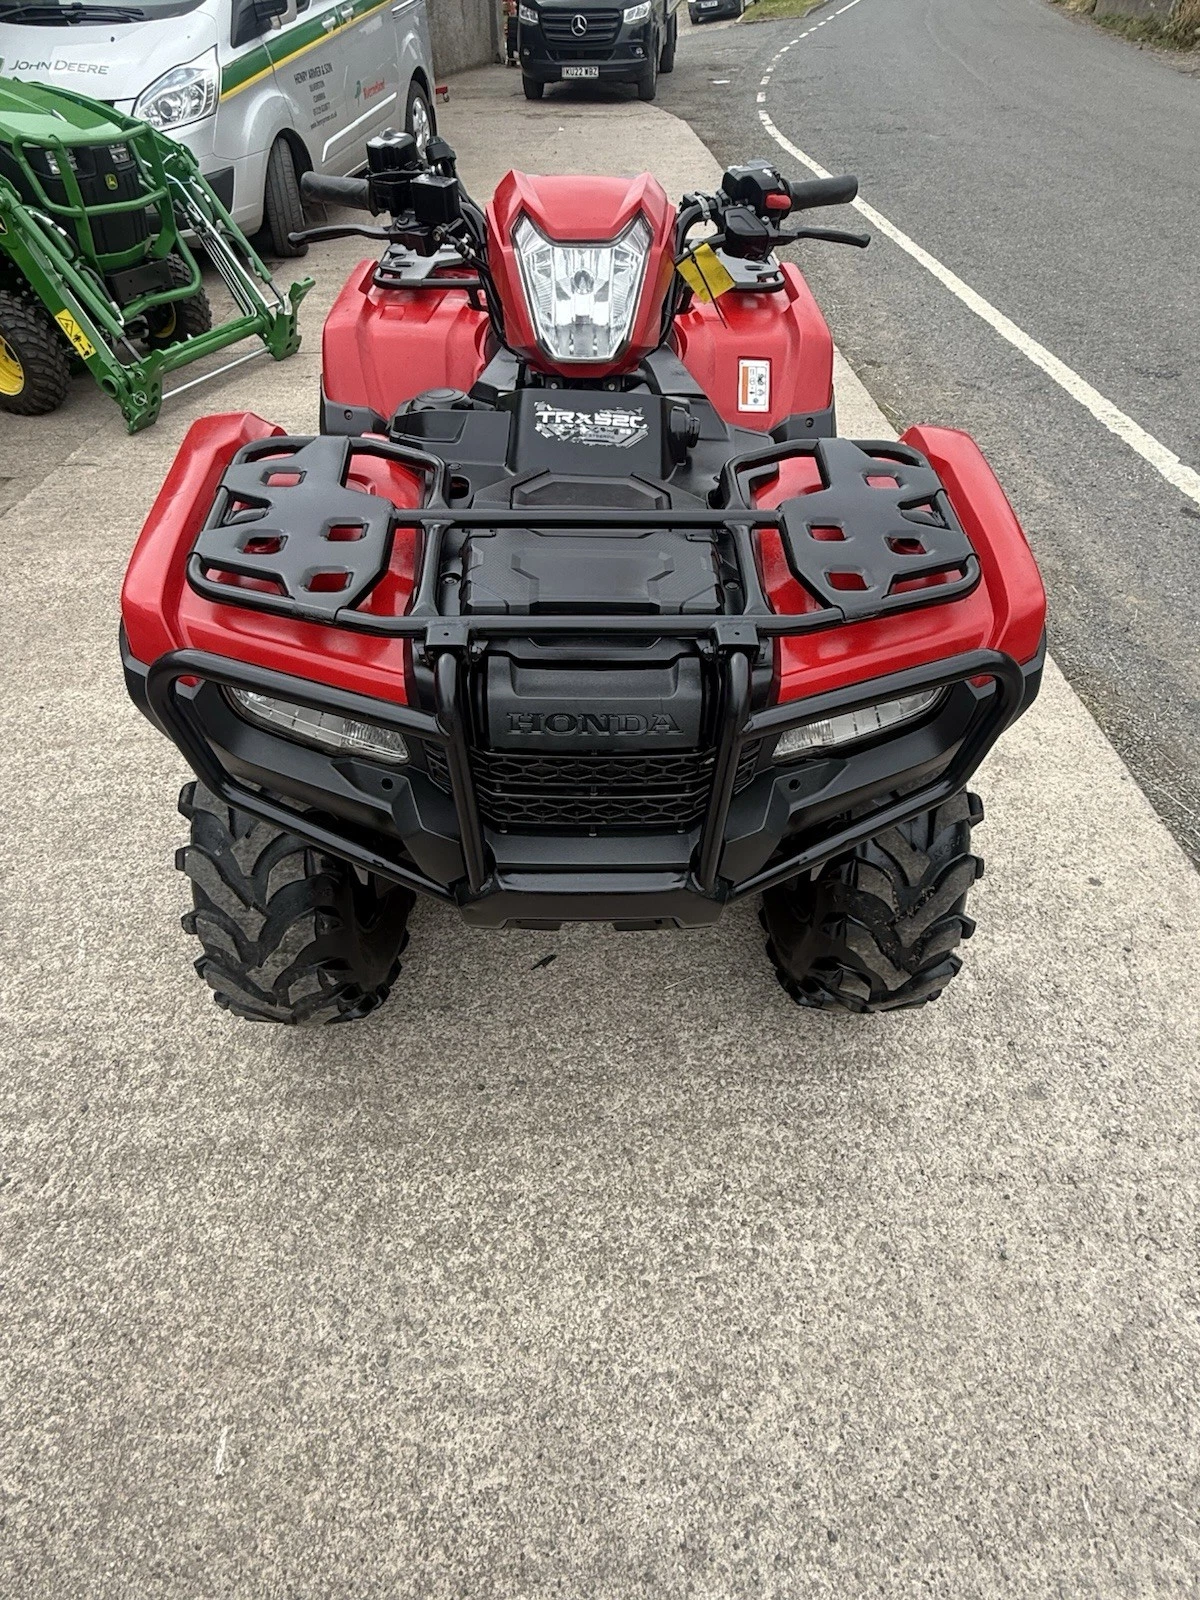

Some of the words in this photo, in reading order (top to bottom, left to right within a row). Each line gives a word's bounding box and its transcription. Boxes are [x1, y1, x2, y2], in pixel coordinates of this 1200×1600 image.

[9, 60, 52, 71] JOHN
[54, 60, 109, 75] DEERE
[507, 712, 684, 736] HONDA
